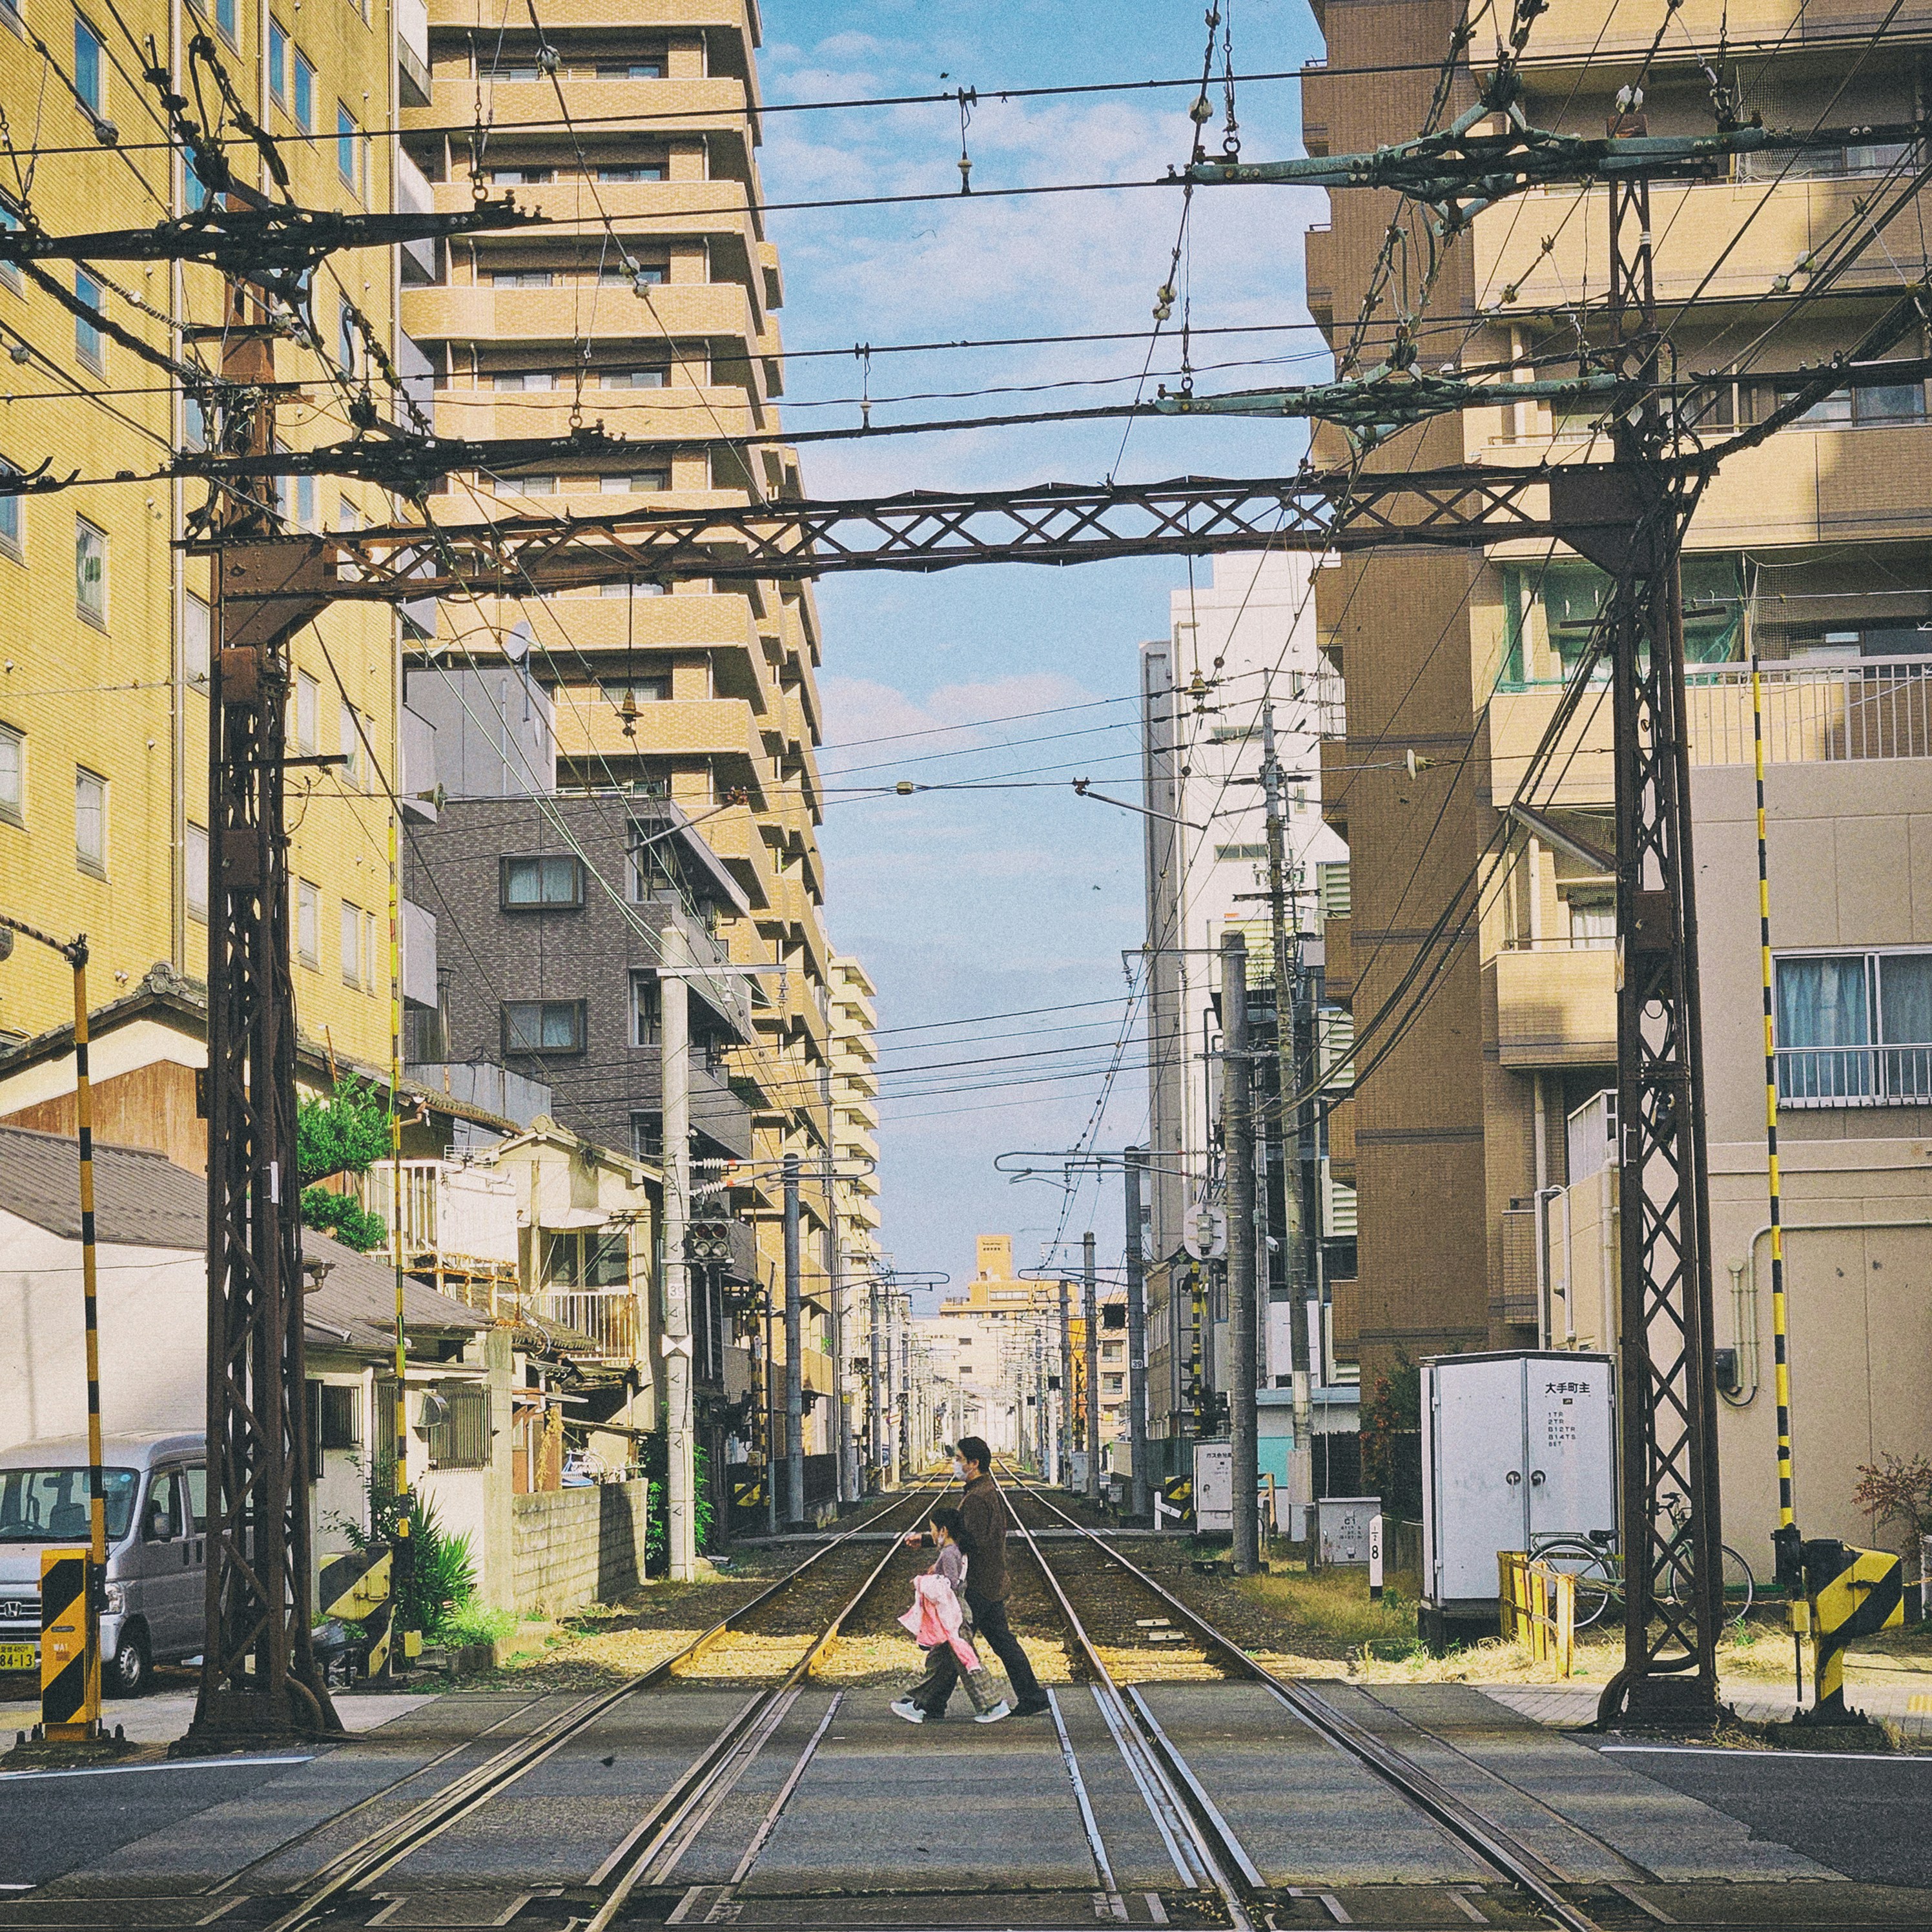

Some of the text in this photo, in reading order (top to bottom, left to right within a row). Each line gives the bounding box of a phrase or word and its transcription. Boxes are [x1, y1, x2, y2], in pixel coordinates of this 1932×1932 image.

[670, 1285, 684, 1297] 39
[1545, 1382, 1590, 1393] 大手町主
[1372, 1545, 1379, 1559] 8
[0, 1654, 33, 1667] 84-13
